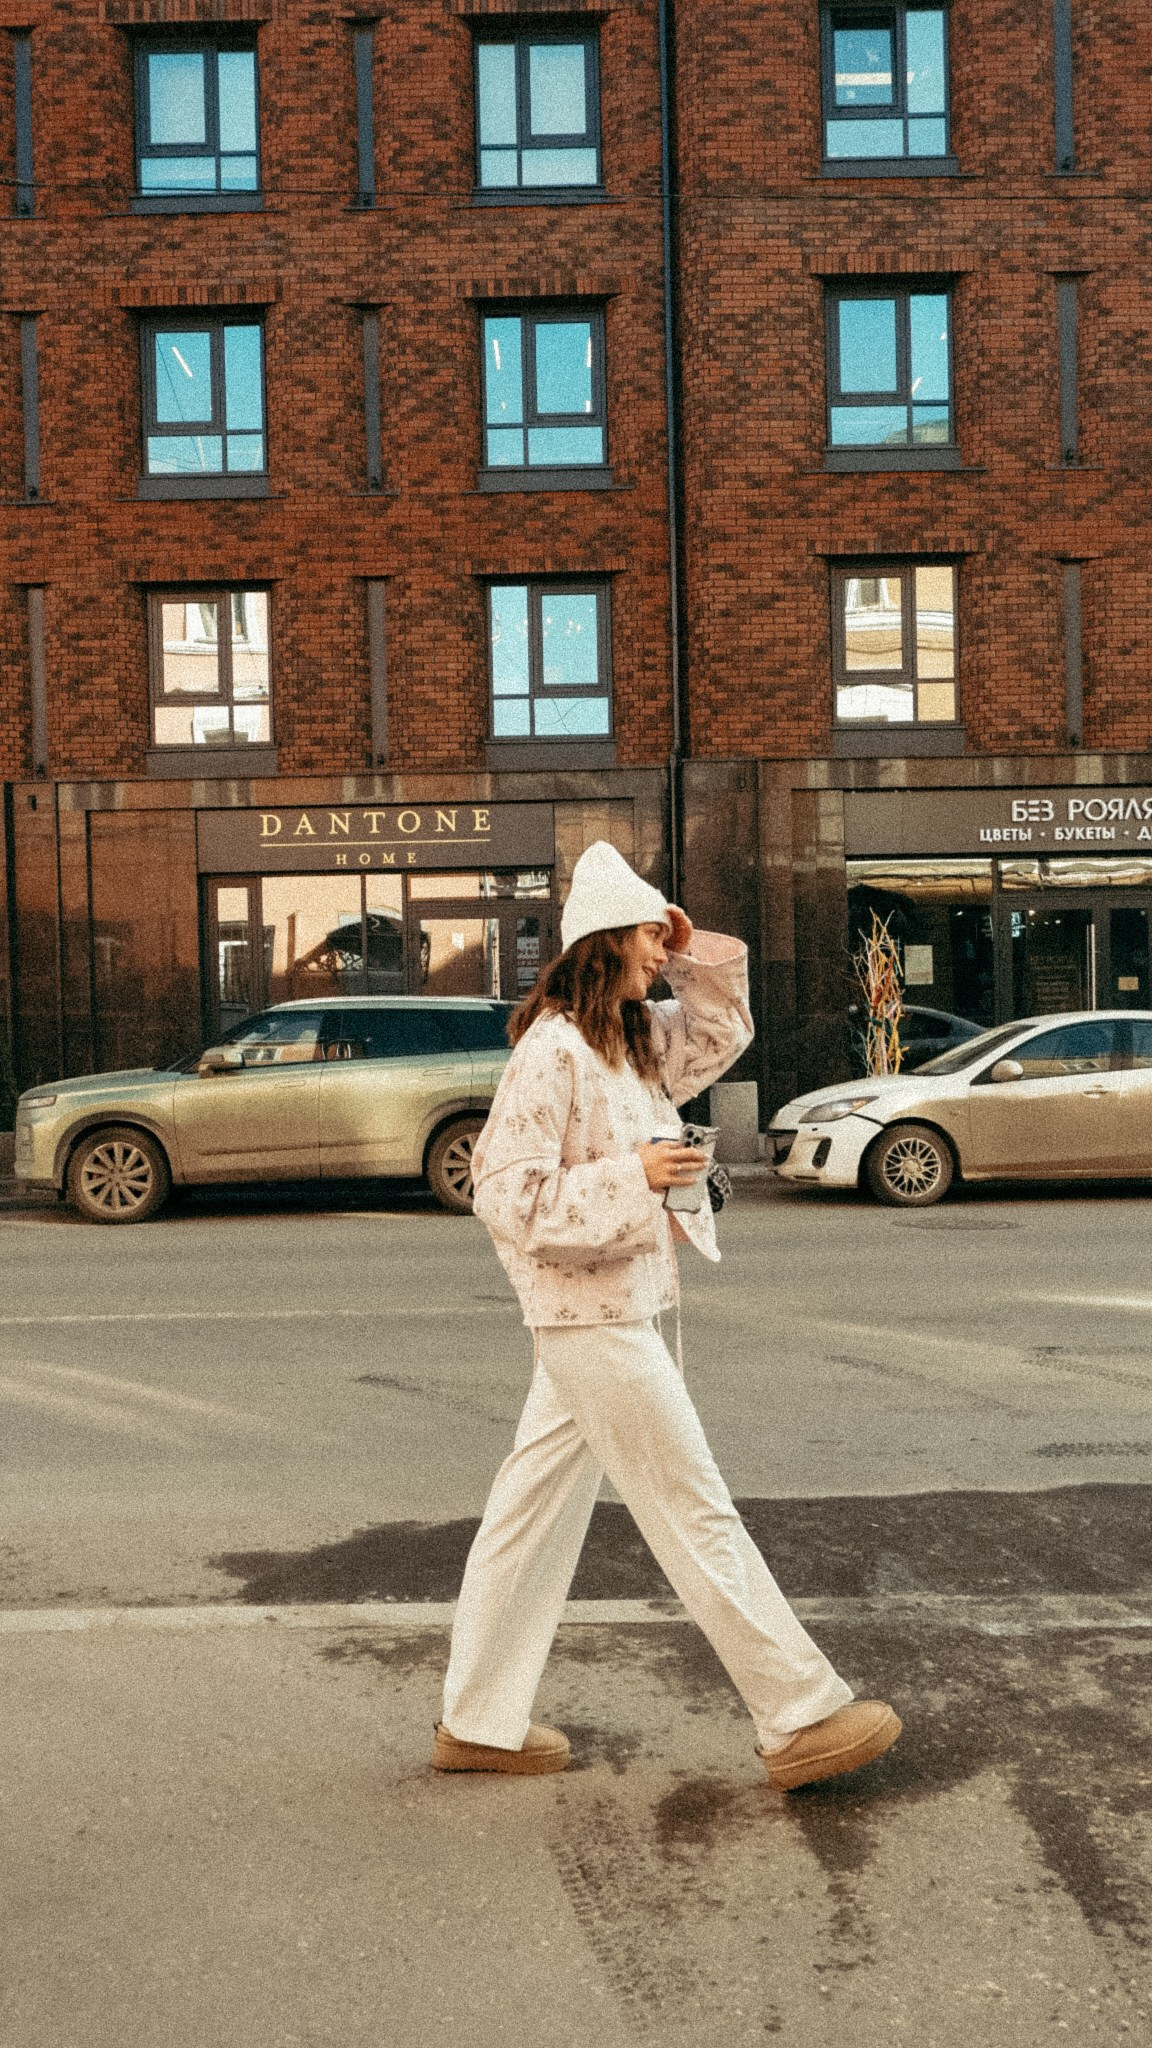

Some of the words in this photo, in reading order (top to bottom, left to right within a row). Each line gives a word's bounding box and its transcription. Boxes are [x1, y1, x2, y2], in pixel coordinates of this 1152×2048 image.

[1011, 799, 1054, 822] БЕЗ
[259, 809, 492, 837] DANTONE
[980, 828, 1032, 843] ЦВЕТЫ
[1054, 826, 1116, 841] БУКЕТЫ
[1136, 825, 1152, 841] Д
[335, 852, 418, 866] HOME
